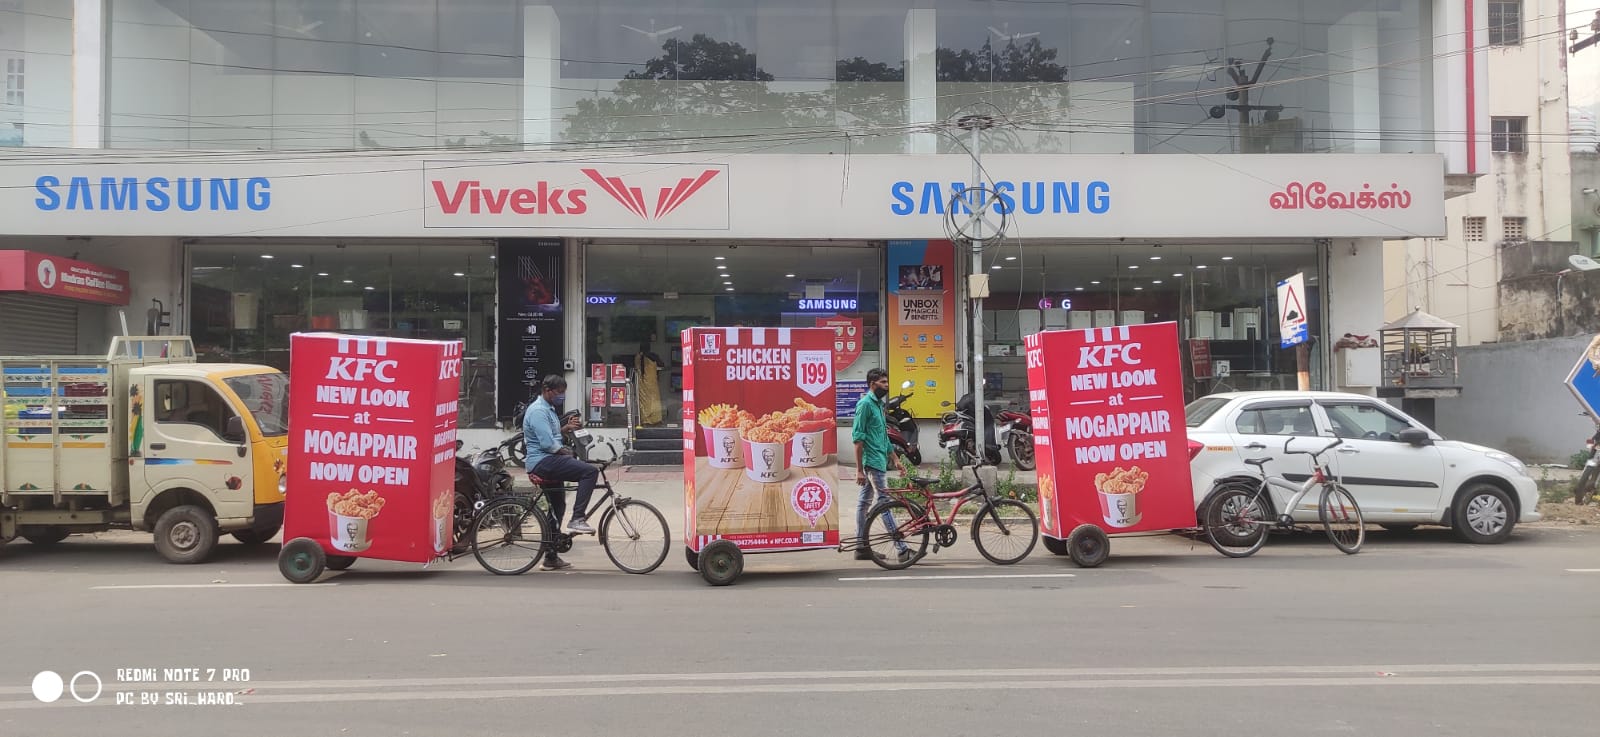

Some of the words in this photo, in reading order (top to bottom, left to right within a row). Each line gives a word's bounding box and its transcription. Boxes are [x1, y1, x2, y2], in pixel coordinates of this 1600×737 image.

[34, 176, 271, 212] SAMSUNG
[431, 180, 587, 215] Viveks
[891, 181, 1111, 216] SAMSUNG
[1268, 181, 1412, 212] விவேக்ஸ்
[798, 299, 857, 310] SAMSUNG
[903, 299, 939, 308] UNBOX
[903, 308, 911, 320] 7
[725, 348, 791, 364] CHICKEN
[1027, 348, 1042, 369] KFC
[1077, 343, 1141, 369] KFC
[326, 357, 398, 383] KFC
[439, 358, 460, 380] KFC
[726, 365, 791, 381] BUCKETS
[800, 363, 828, 384] 199
[1070, 372, 1108, 391] NEW
[1111, 369, 1157, 389] LOOK
[316, 385, 357, 404] NEW
[361, 388, 410, 408] LOOK
[1108, 393, 1124, 406] at
[353, 411, 371, 425] at
[1065, 410, 1171, 440] MOGAPPAIR
[303, 429, 418, 460] MOGAPPAIR
[1075, 444, 1116, 464] NOW
[1119, 440, 1167, 460] OPEN
[310, 462, 354, 482] NOW
[358, 465, 409, 486] OPEN
[799, 490, 822, 503] 4X
